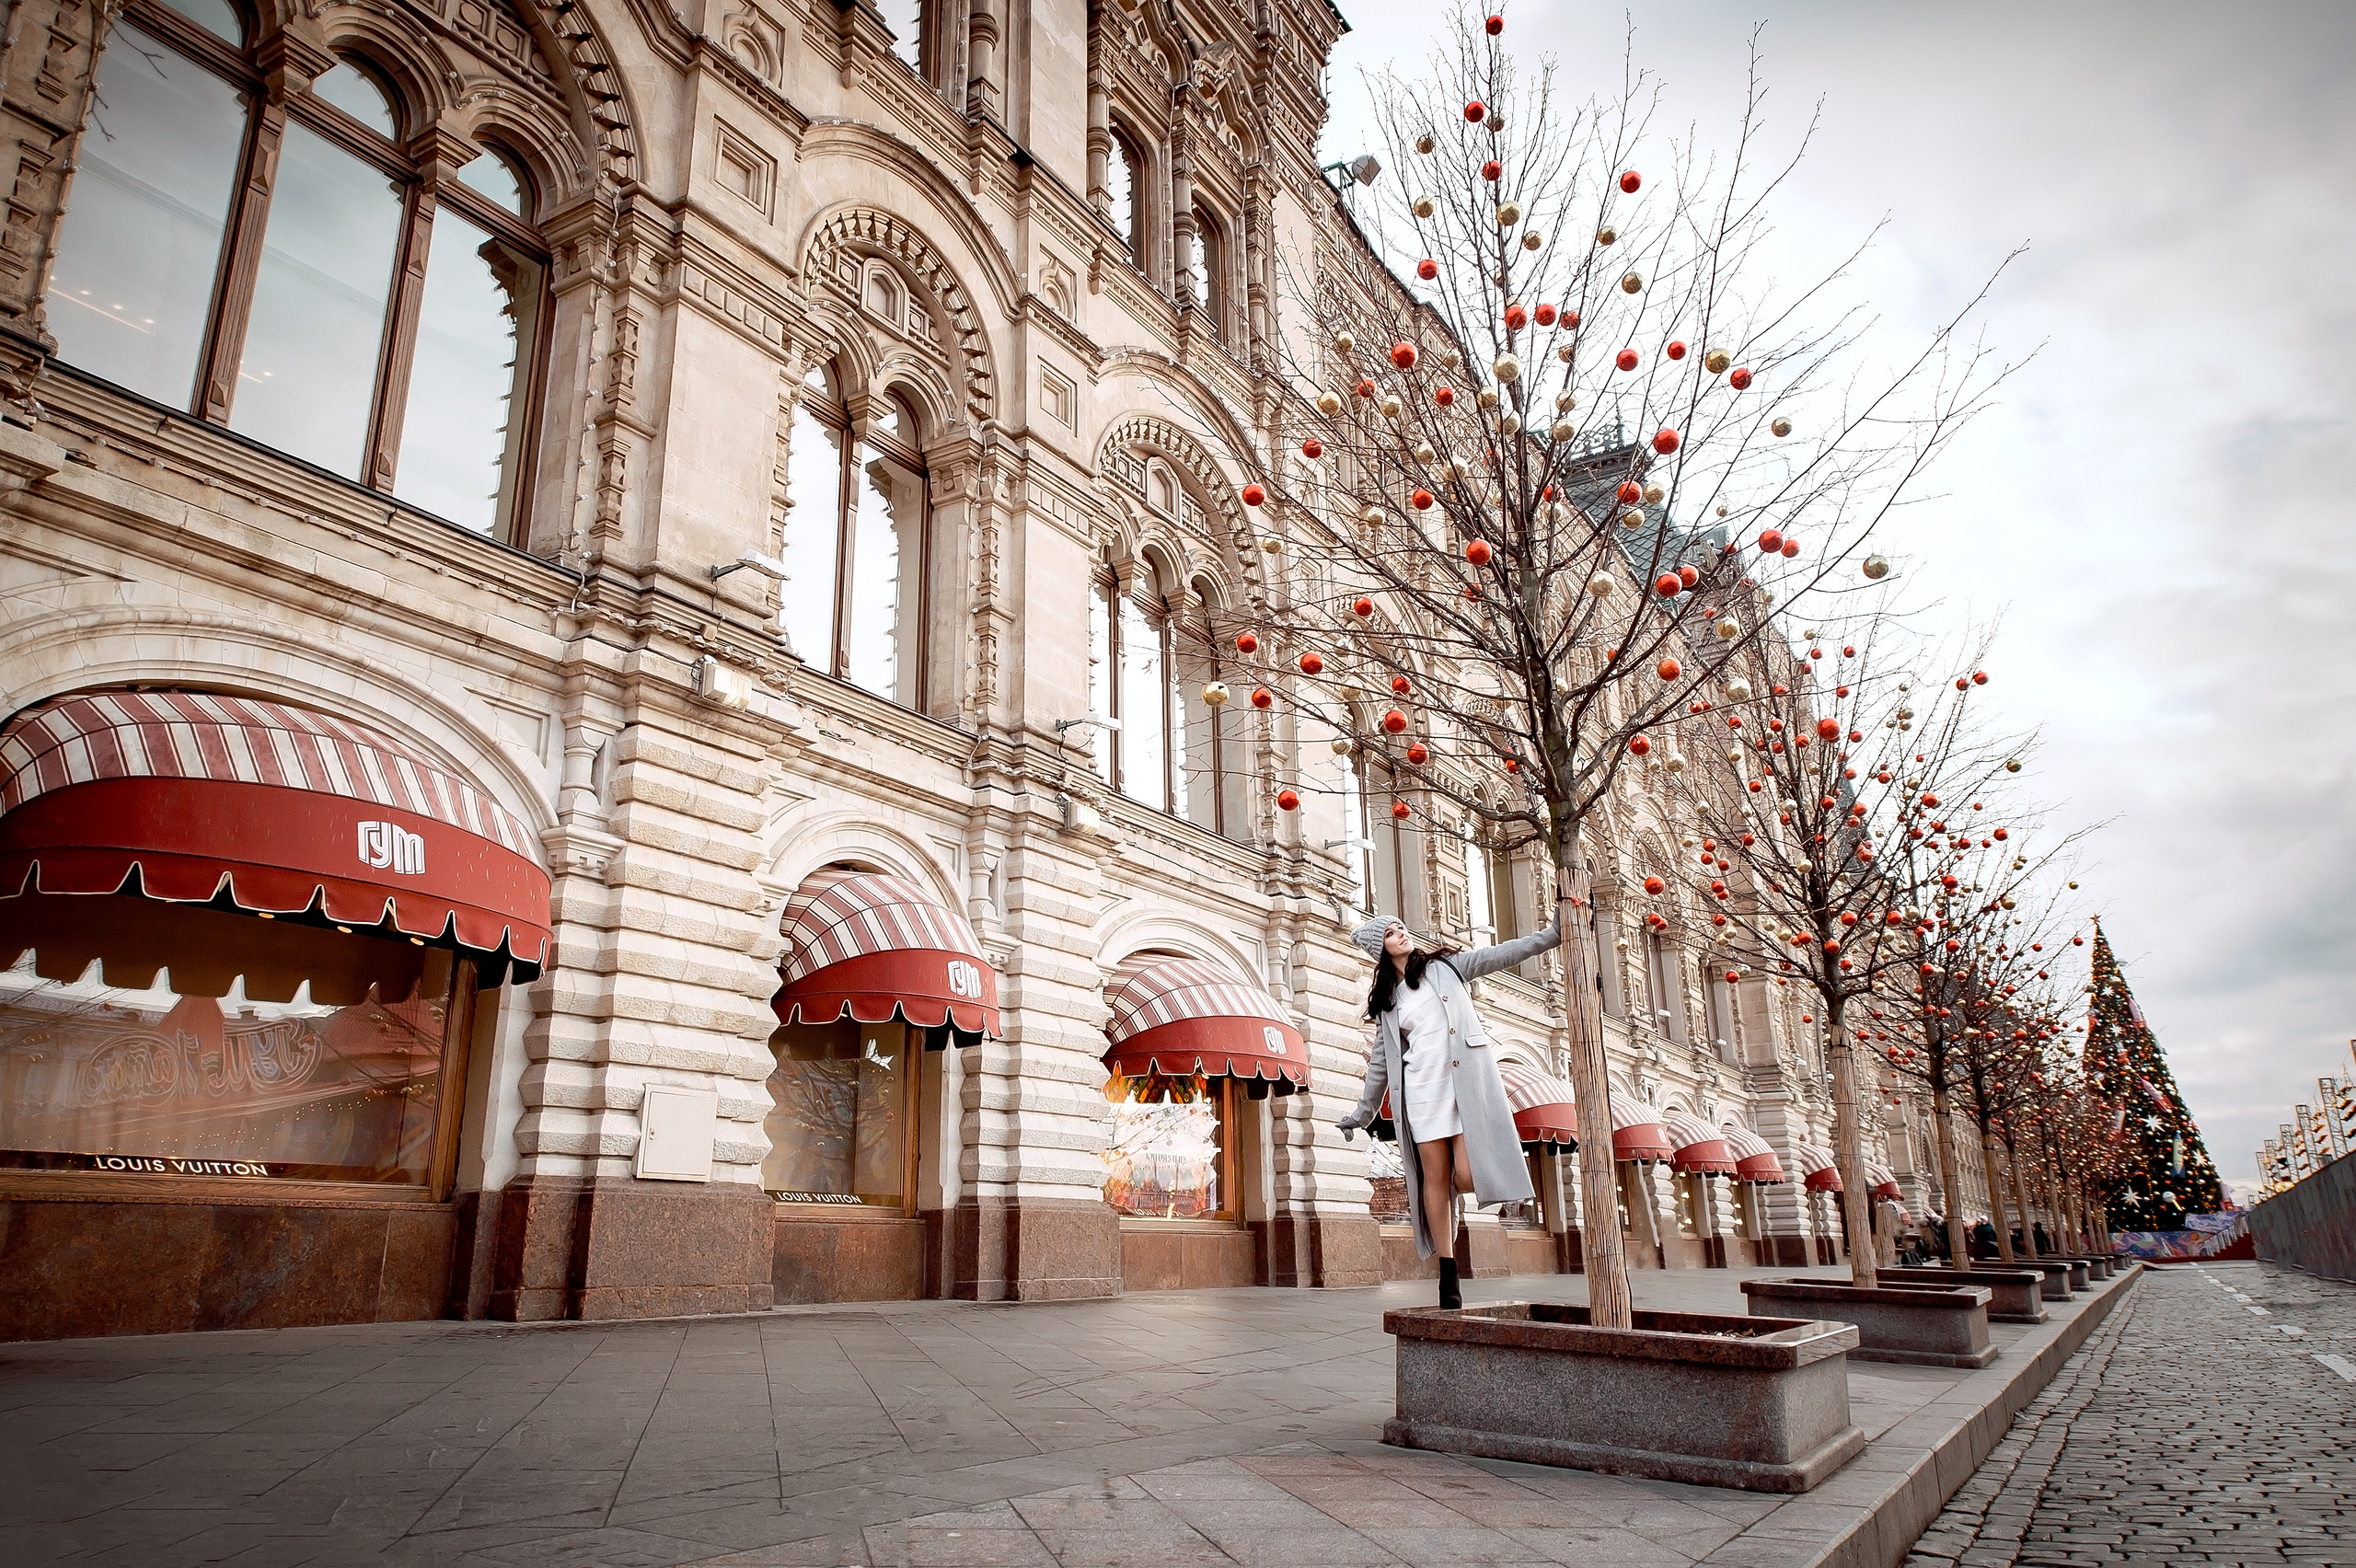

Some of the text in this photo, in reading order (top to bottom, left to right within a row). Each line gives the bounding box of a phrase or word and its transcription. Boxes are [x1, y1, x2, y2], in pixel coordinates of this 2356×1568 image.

[96, 1157, 269, 1176] LOUIS VUITTON
[776, 1192, 863, 1205] LOUIS VUITTON
